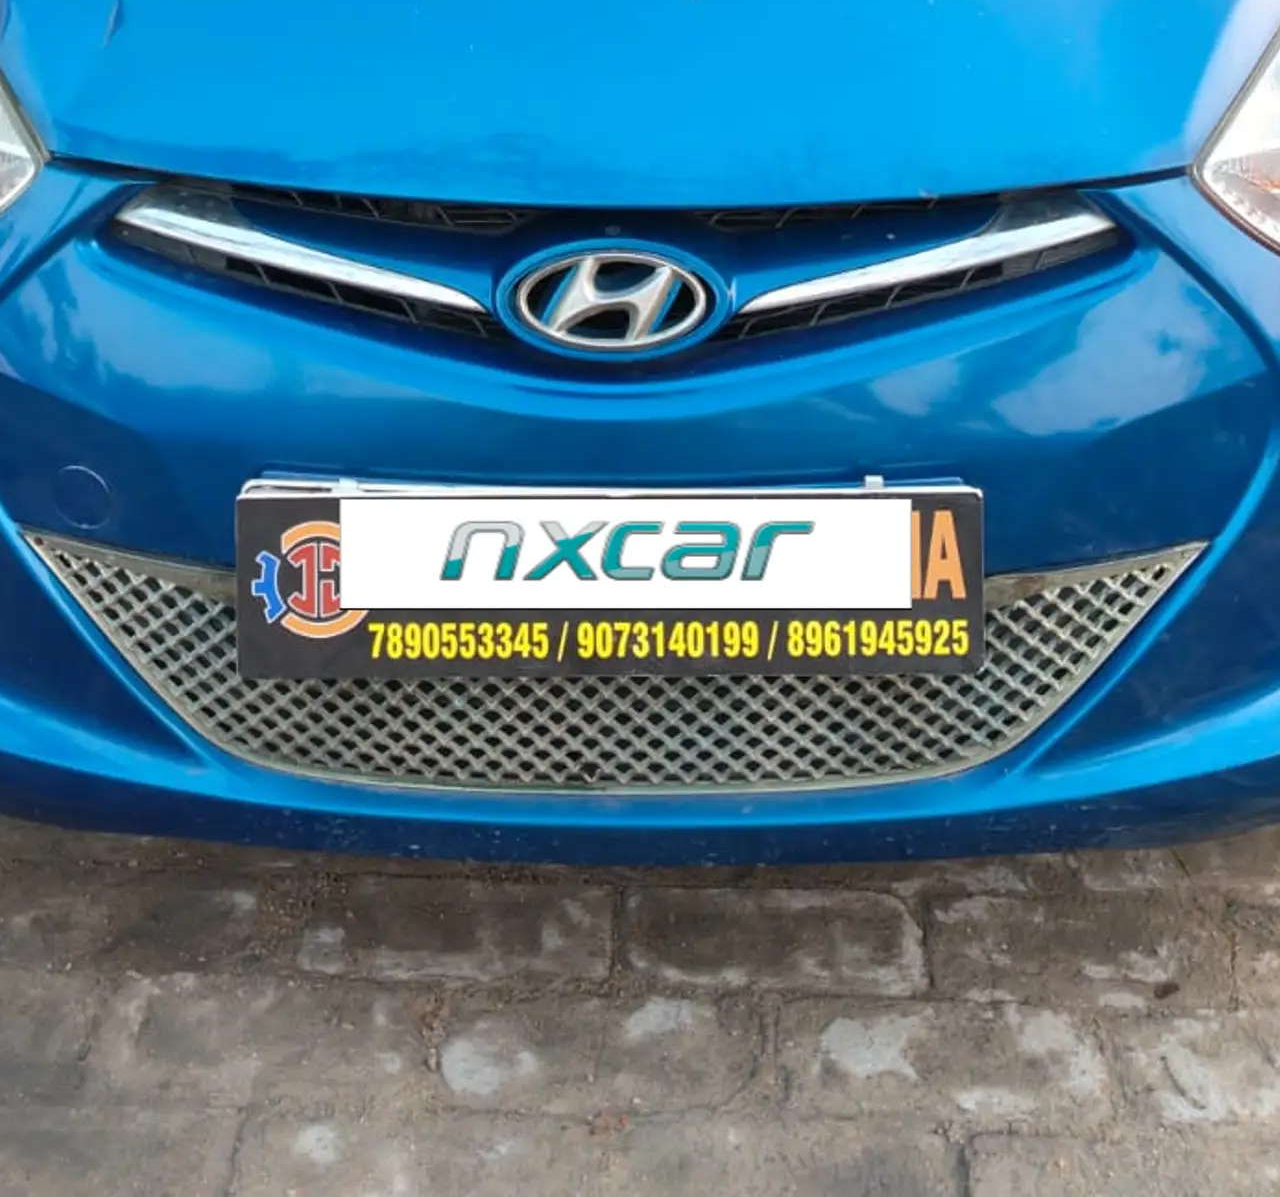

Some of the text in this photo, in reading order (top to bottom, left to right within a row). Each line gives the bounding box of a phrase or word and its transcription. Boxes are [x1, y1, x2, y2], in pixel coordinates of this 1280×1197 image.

[368, 618, 969, 663] 7890553345 / 9073140199 / 8961945925
